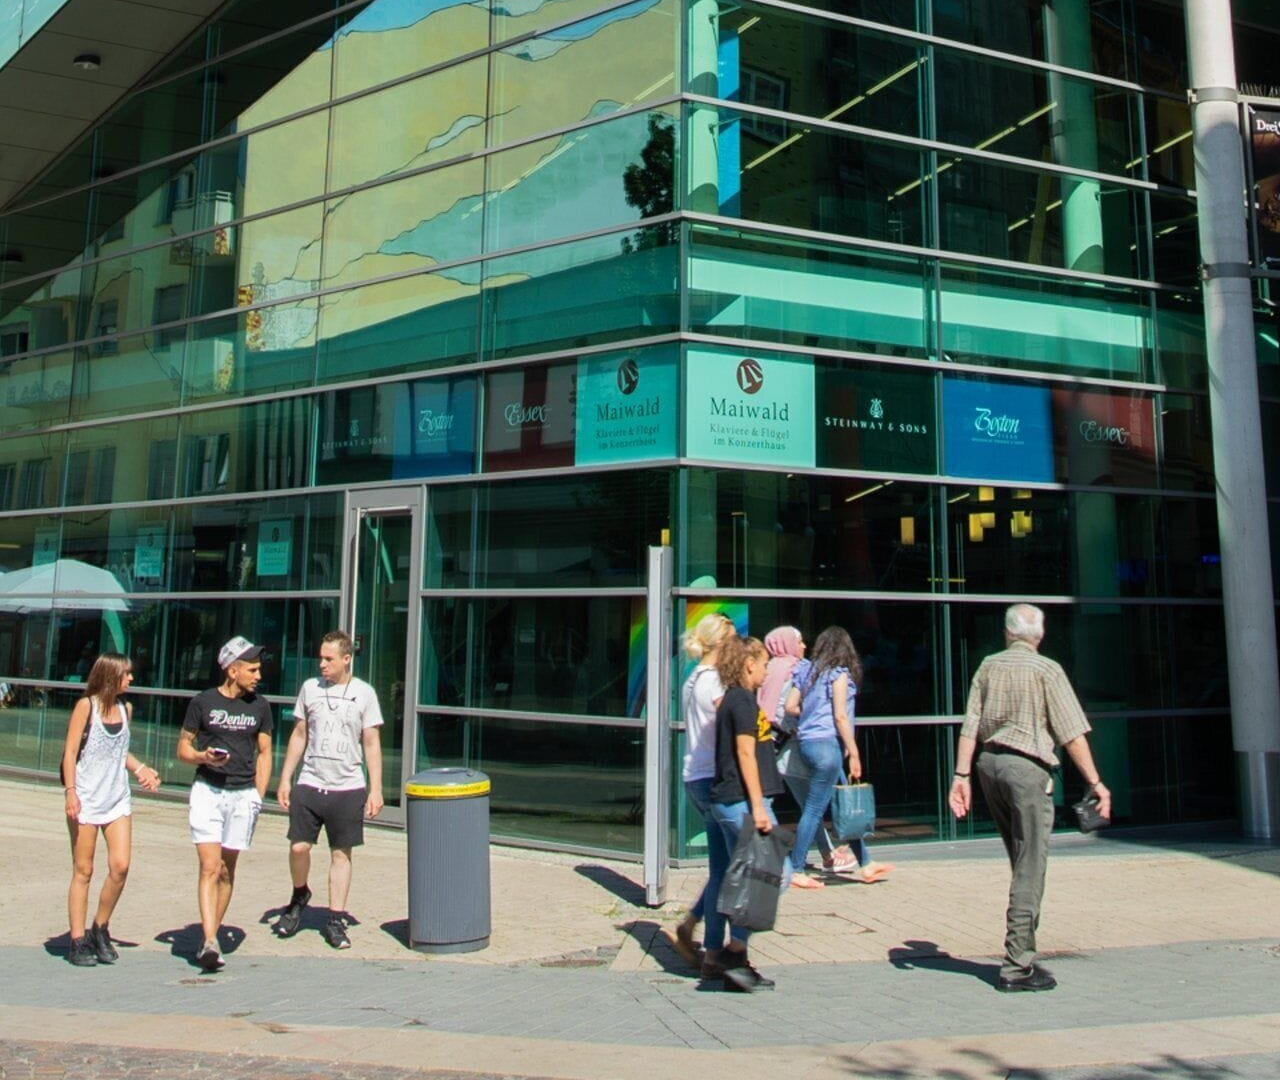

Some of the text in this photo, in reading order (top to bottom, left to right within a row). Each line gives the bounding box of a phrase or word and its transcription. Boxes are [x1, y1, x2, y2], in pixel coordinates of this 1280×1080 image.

[1256, 120, 1278, 132] Drei
[504, 401, 553, 426] Essex
[595, 396, 660, 422] Maiwald
[709, 396, 790, 422] Maiwald
[595, 423, 660, 439] Klaviere & Flügel
[709, 423, 790, 440] Klaviere & Flügel
[824, 417, 928, 435] STEINWAY & SONS
[1079, 420, 1131, 446] Essex
[609, 437, 657, 450] Konzerthaus
[713, 437, 787, 451] im Konzerthaus
